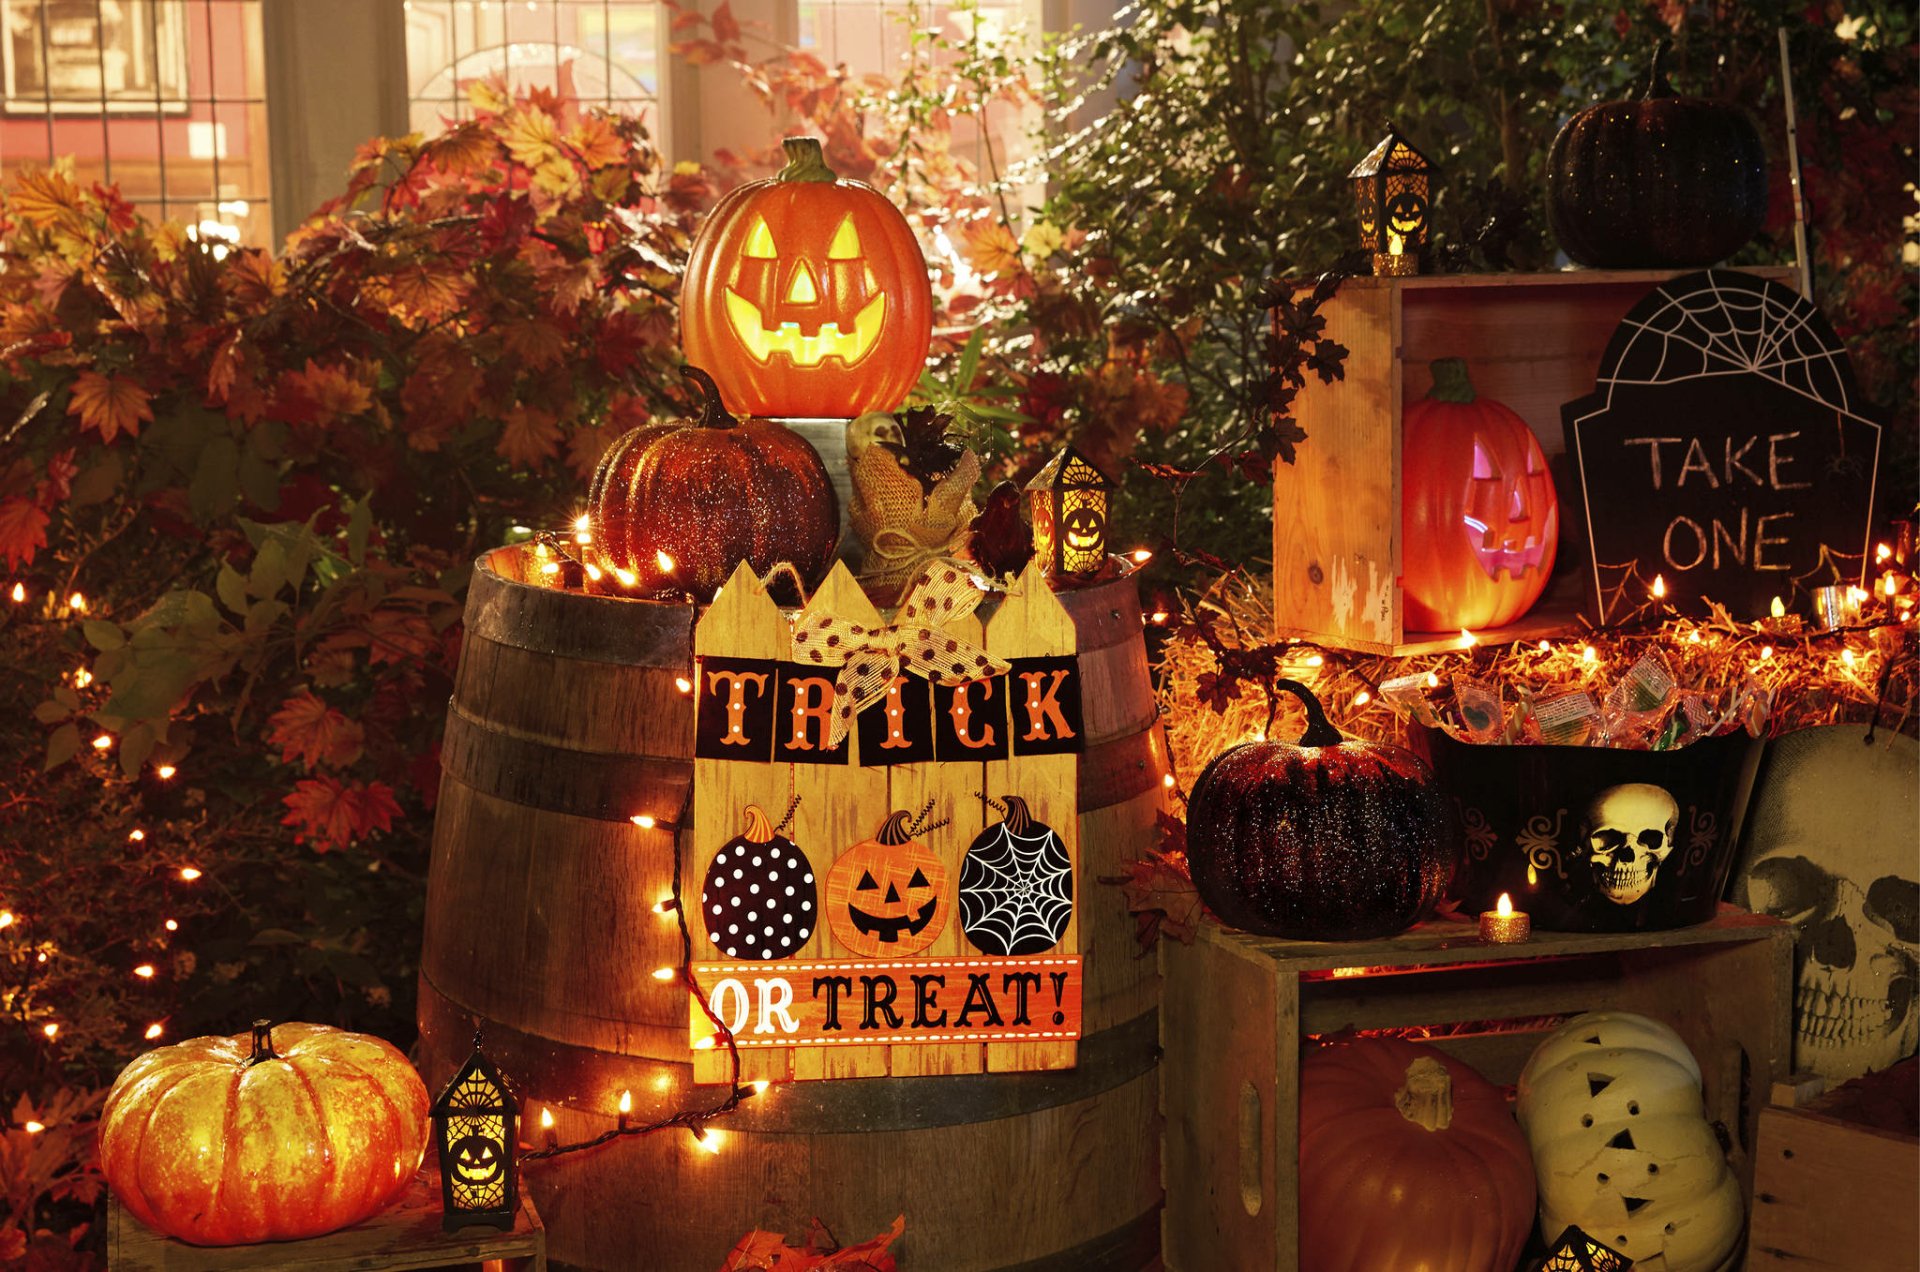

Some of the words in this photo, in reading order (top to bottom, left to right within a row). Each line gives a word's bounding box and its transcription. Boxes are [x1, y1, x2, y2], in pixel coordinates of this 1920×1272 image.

[1624, 431, 1812, 490] TAKE
[1663, 507, 1794, 571] ONE
[707, 669, 1076, 750] TRICK
[709, 977, 799, 1036] OR
[812, 972, 1068, 1031] TREAT!
